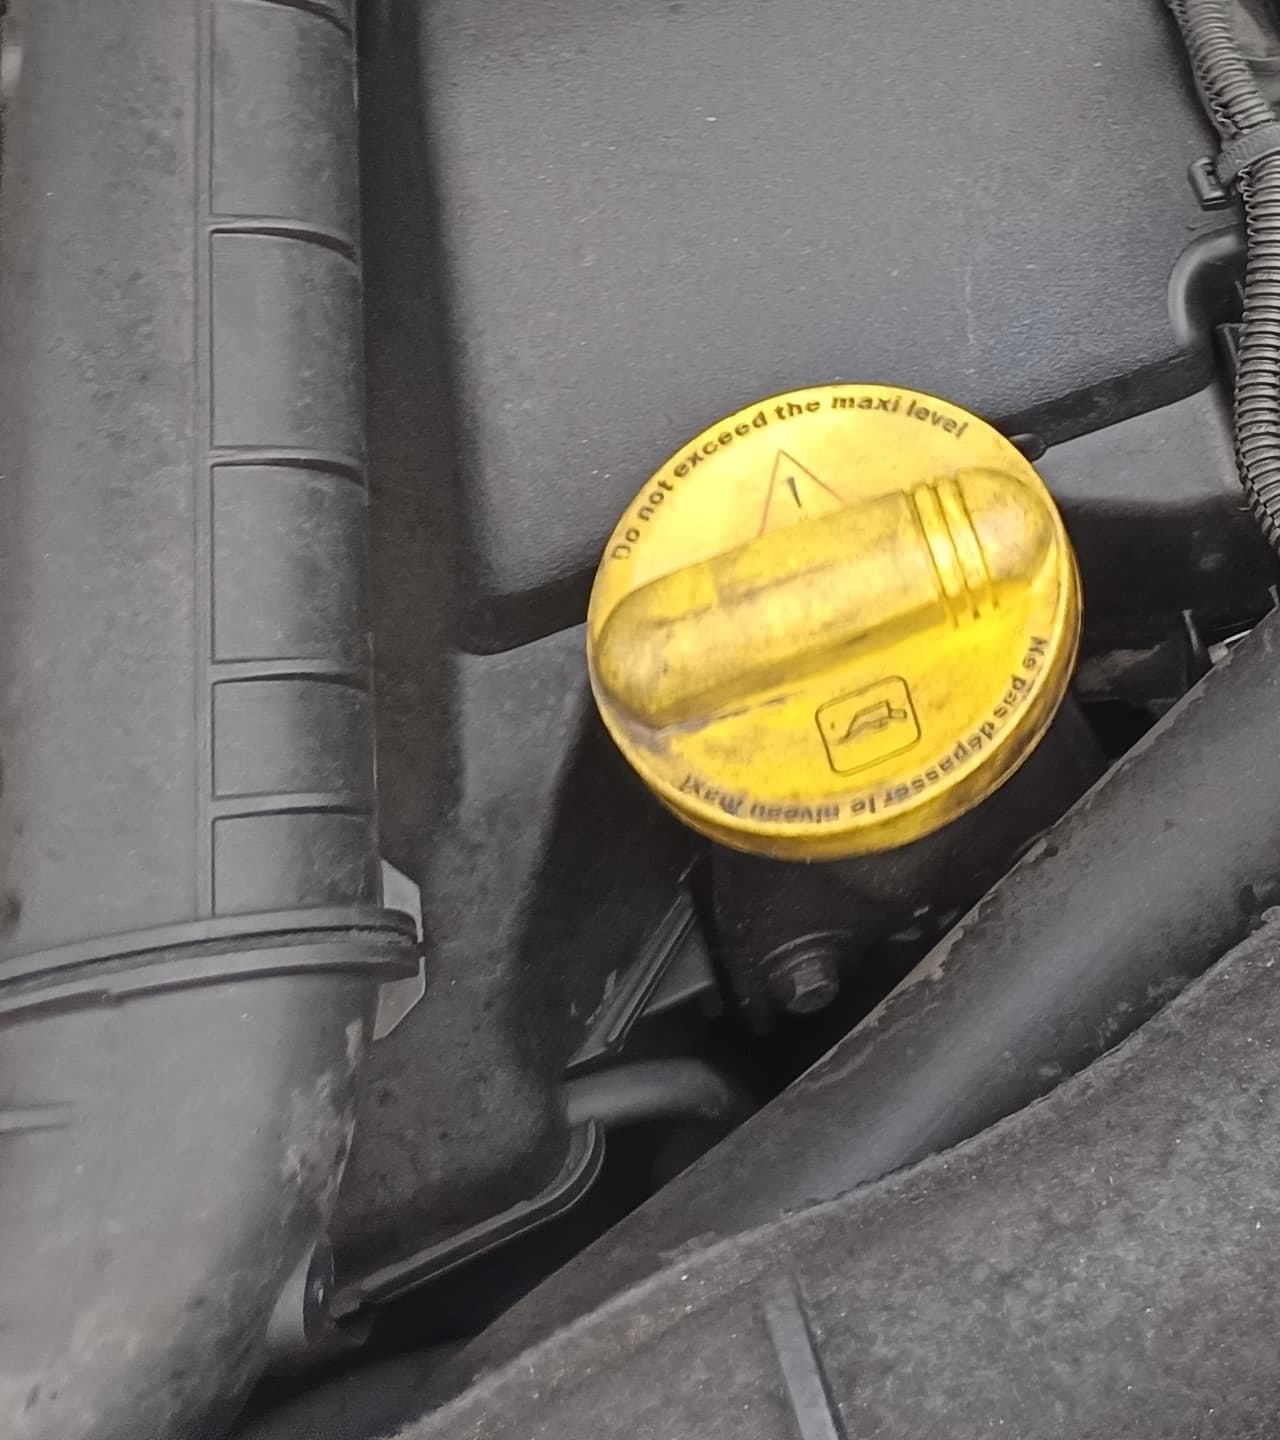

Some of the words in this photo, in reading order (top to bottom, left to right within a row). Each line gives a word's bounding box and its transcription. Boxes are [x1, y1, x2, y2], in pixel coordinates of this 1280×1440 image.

[611, 527, 641, 561] Do
[638, 477, 674, 522] not
[673, 411, 768, 478] exceed
[774, 395, 821, 422] the
[830, 394, 902, 413] maxi
[906, 398, 970, 440] level
[993, 673, 1030, 718] pas
[883, 720, 997, 809] dépasser
[749, 803, 840, 825] niveau
[850, 798, 877, 815] le
